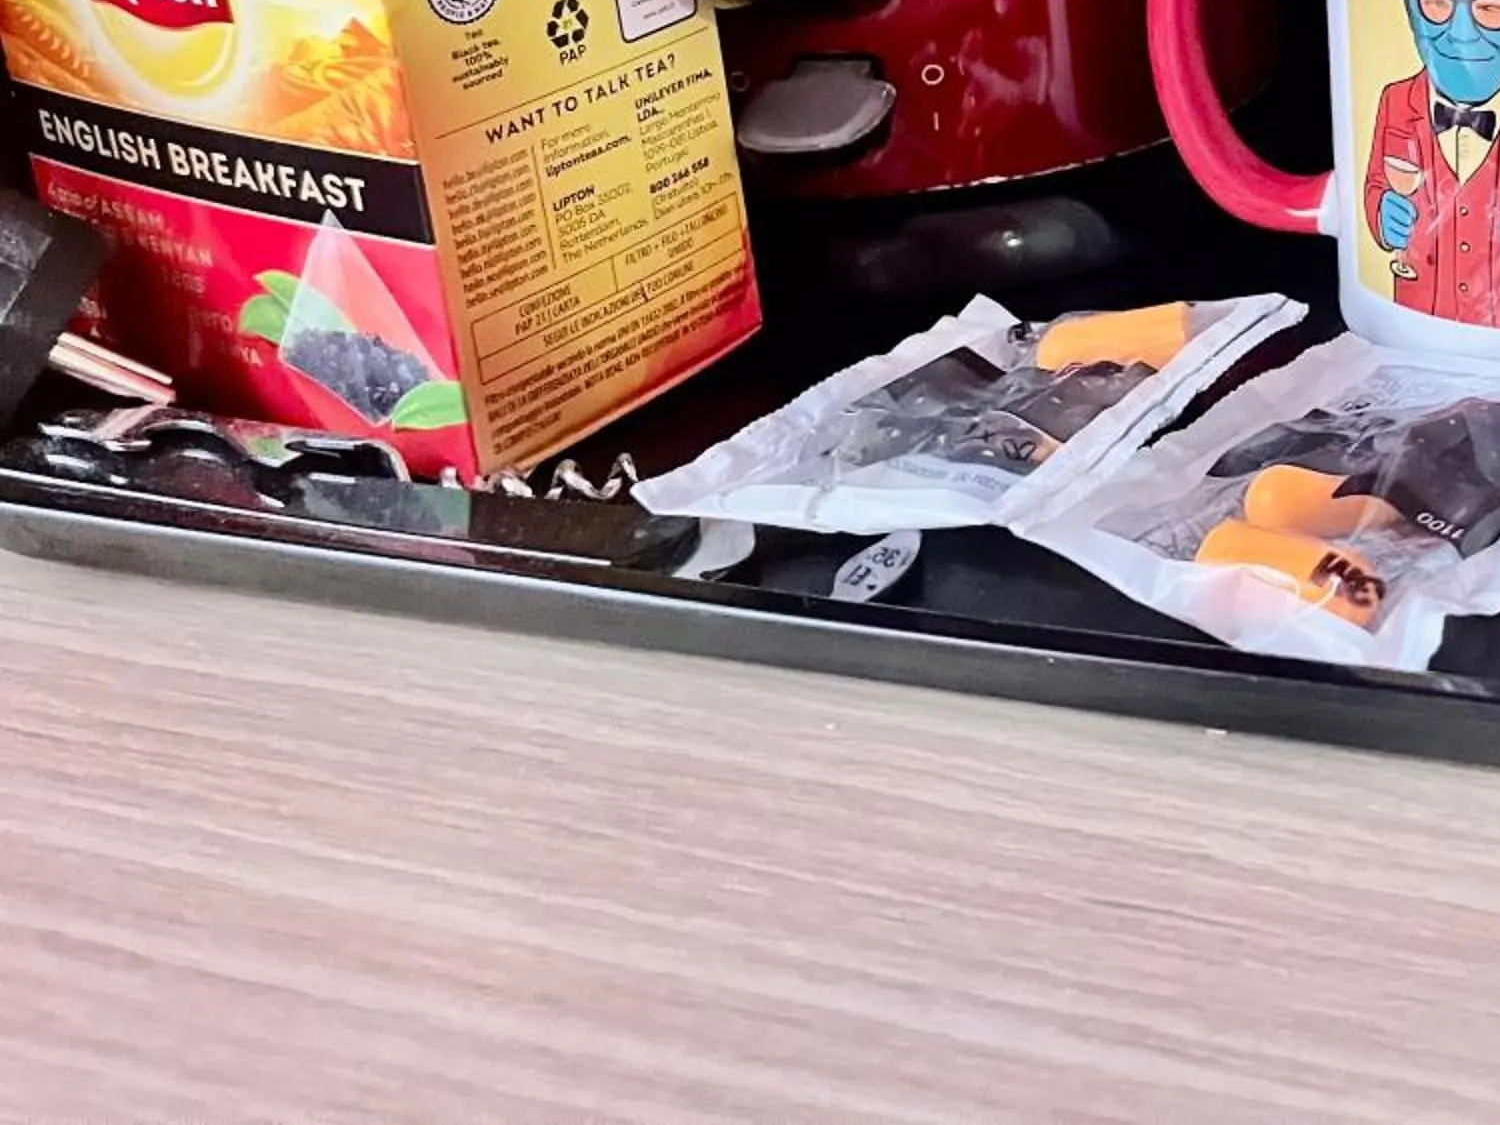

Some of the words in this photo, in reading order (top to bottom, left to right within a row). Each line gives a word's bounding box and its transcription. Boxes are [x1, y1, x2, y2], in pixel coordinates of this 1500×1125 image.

[559, 44, 588, 66] PAP
[485, 106, 545, 144] WANT
[552, 95, 579, 118] TO
[584, 71, 631, 105] TALK
[634, 53, 677, 83] TEA?
[635, 79, 684, 110] UNILEVER
[38, 108, 162, 172] ENGLISH
[169, 143, 366, 213] BREAKFAST
[553, 183, 596, 212] LIPTON
[555, 209, 573, 225] PO
[588, 210, 606, 224] DA
[562, 249, 583, 265] The
